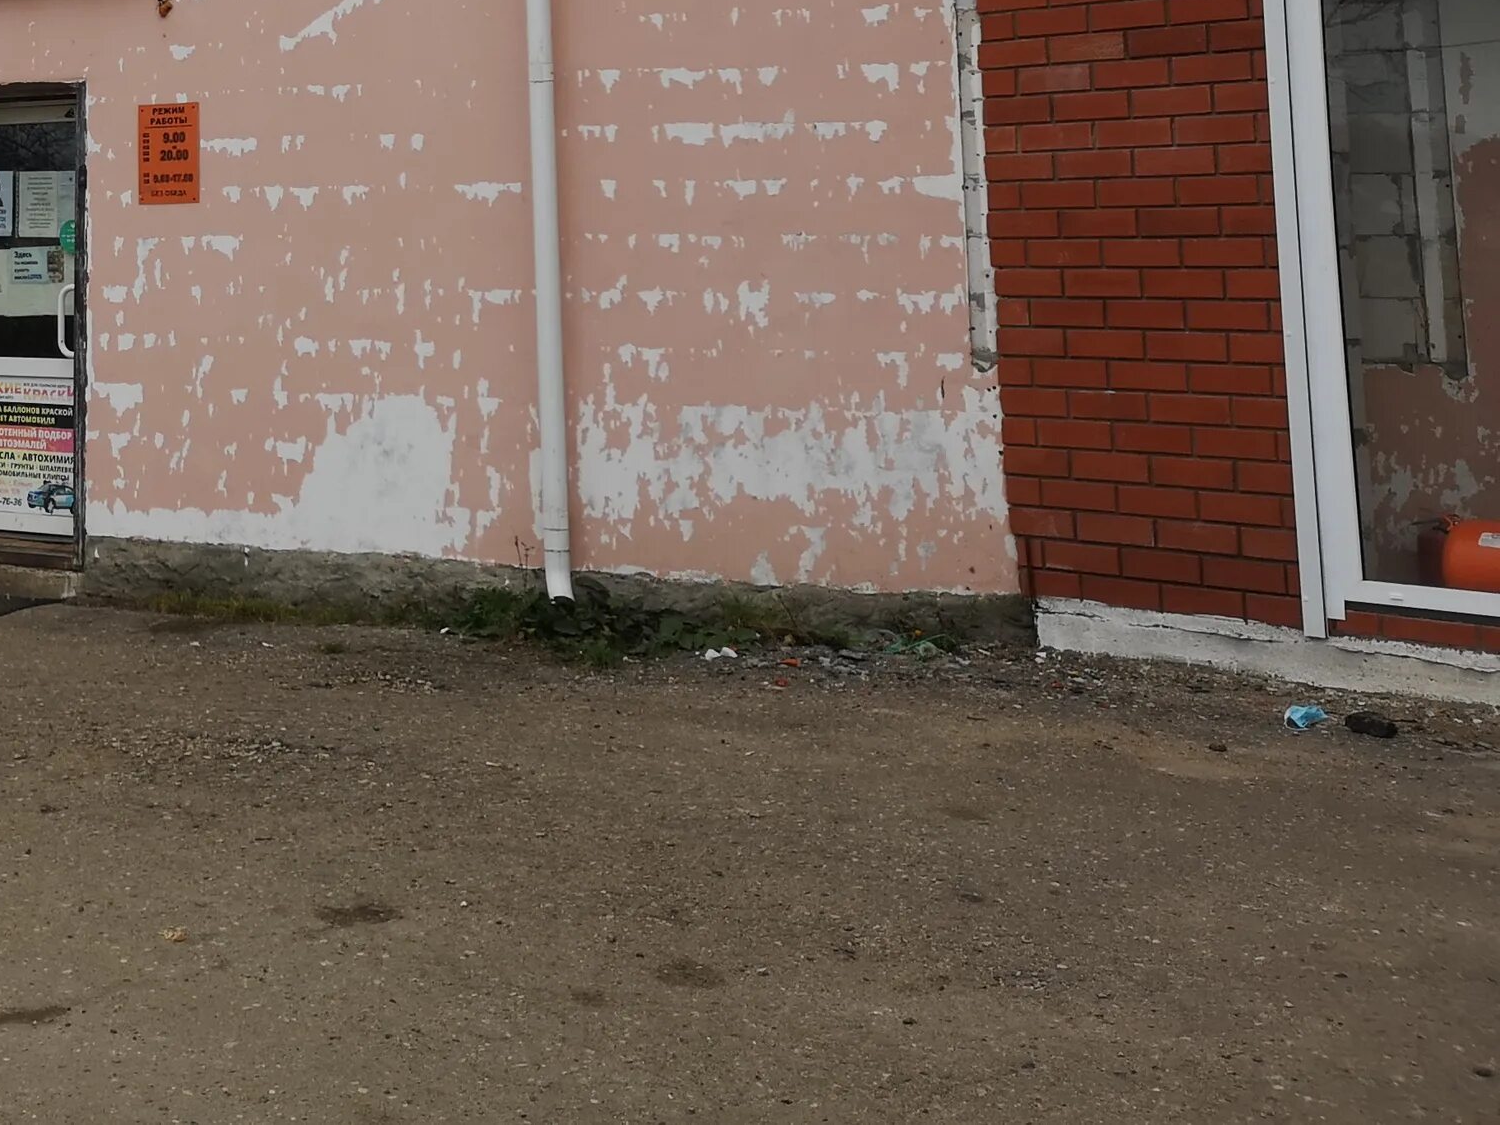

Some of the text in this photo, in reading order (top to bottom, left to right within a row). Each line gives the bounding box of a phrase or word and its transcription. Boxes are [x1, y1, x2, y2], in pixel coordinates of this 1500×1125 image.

[152, 106, 185, 115] РЕЖИМ
[150, 117, 187, 125] РАБОТЫ
[160, 149, 189, 161] 20.00
[3, 406, 40, 414] БАЛЛОНОВ
[41, 407, 73, 416] КРАСКОЙ
[8, 415, 56, 425] АВТОМОБИЛЯ
[39, 429, 73, 441] ПОДБОР
[22, 453, 75, 464] АВТОХИМИЯ
